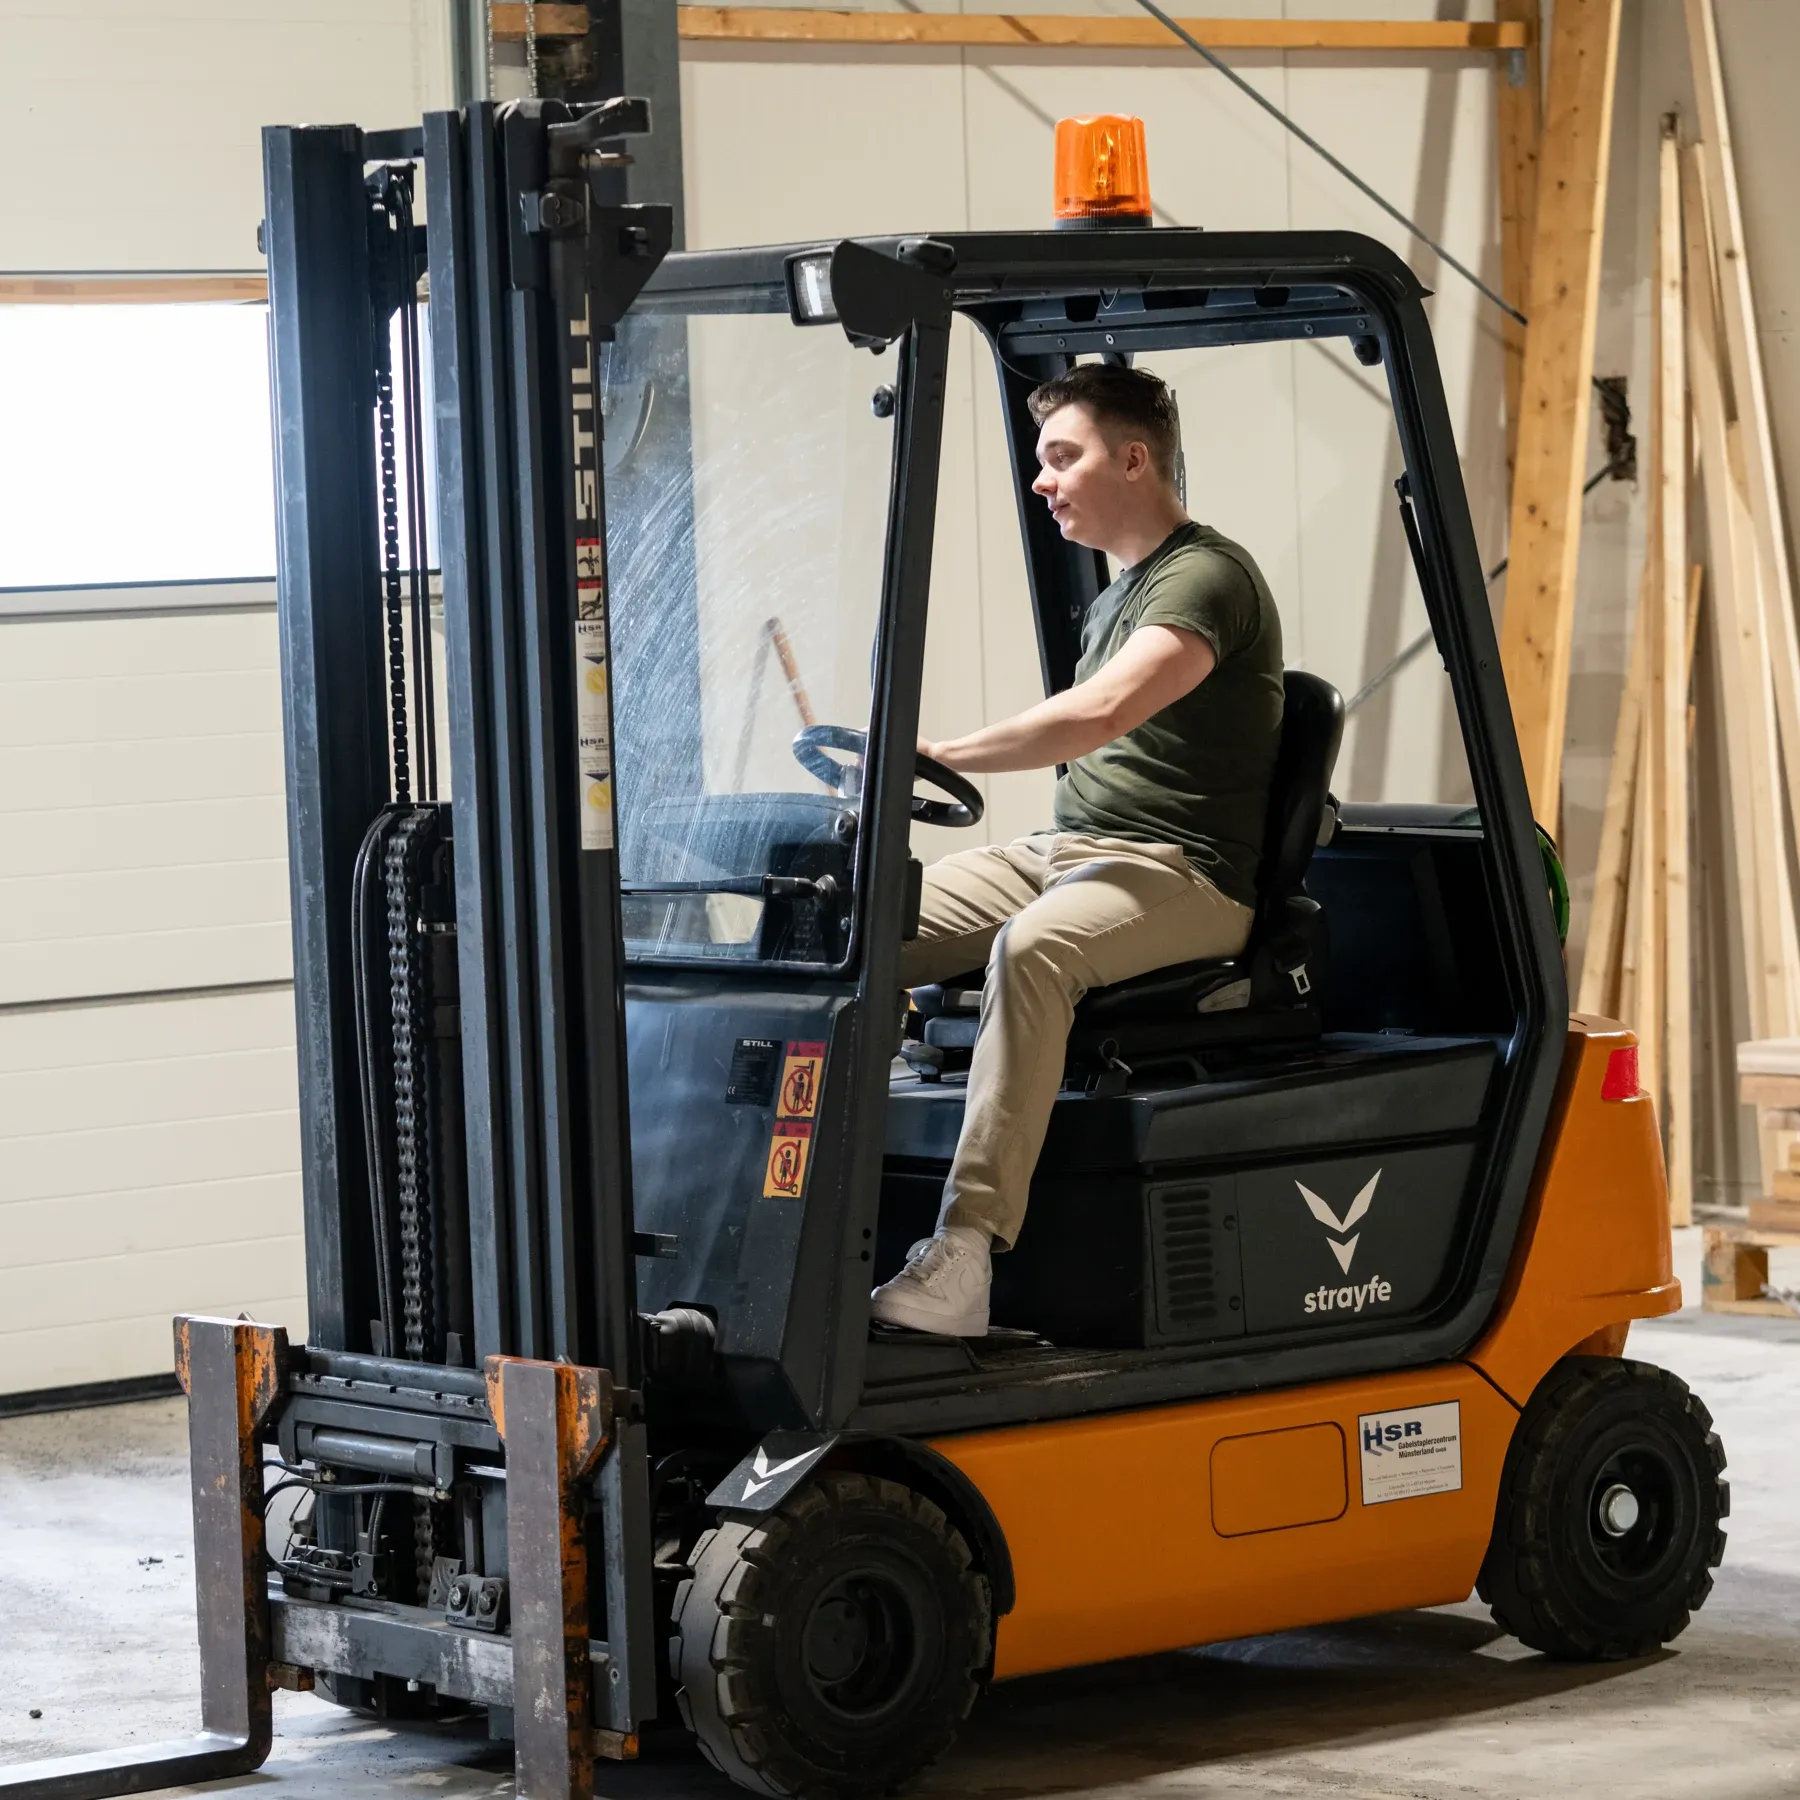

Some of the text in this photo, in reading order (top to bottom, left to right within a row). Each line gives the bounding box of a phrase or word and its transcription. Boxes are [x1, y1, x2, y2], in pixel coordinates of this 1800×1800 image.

[570, 292, 597, 520] STILL
[742, 1039, 774, 1048] STILL
[1303, 1274, 1392, 1314] strayfe
[1363, 1420, 1423, 1452] HSR
[1398, 1435, 1457, 1450] Gabelstaplerzentrum
[1398, 1446, 1435, 1459] Münsterland
